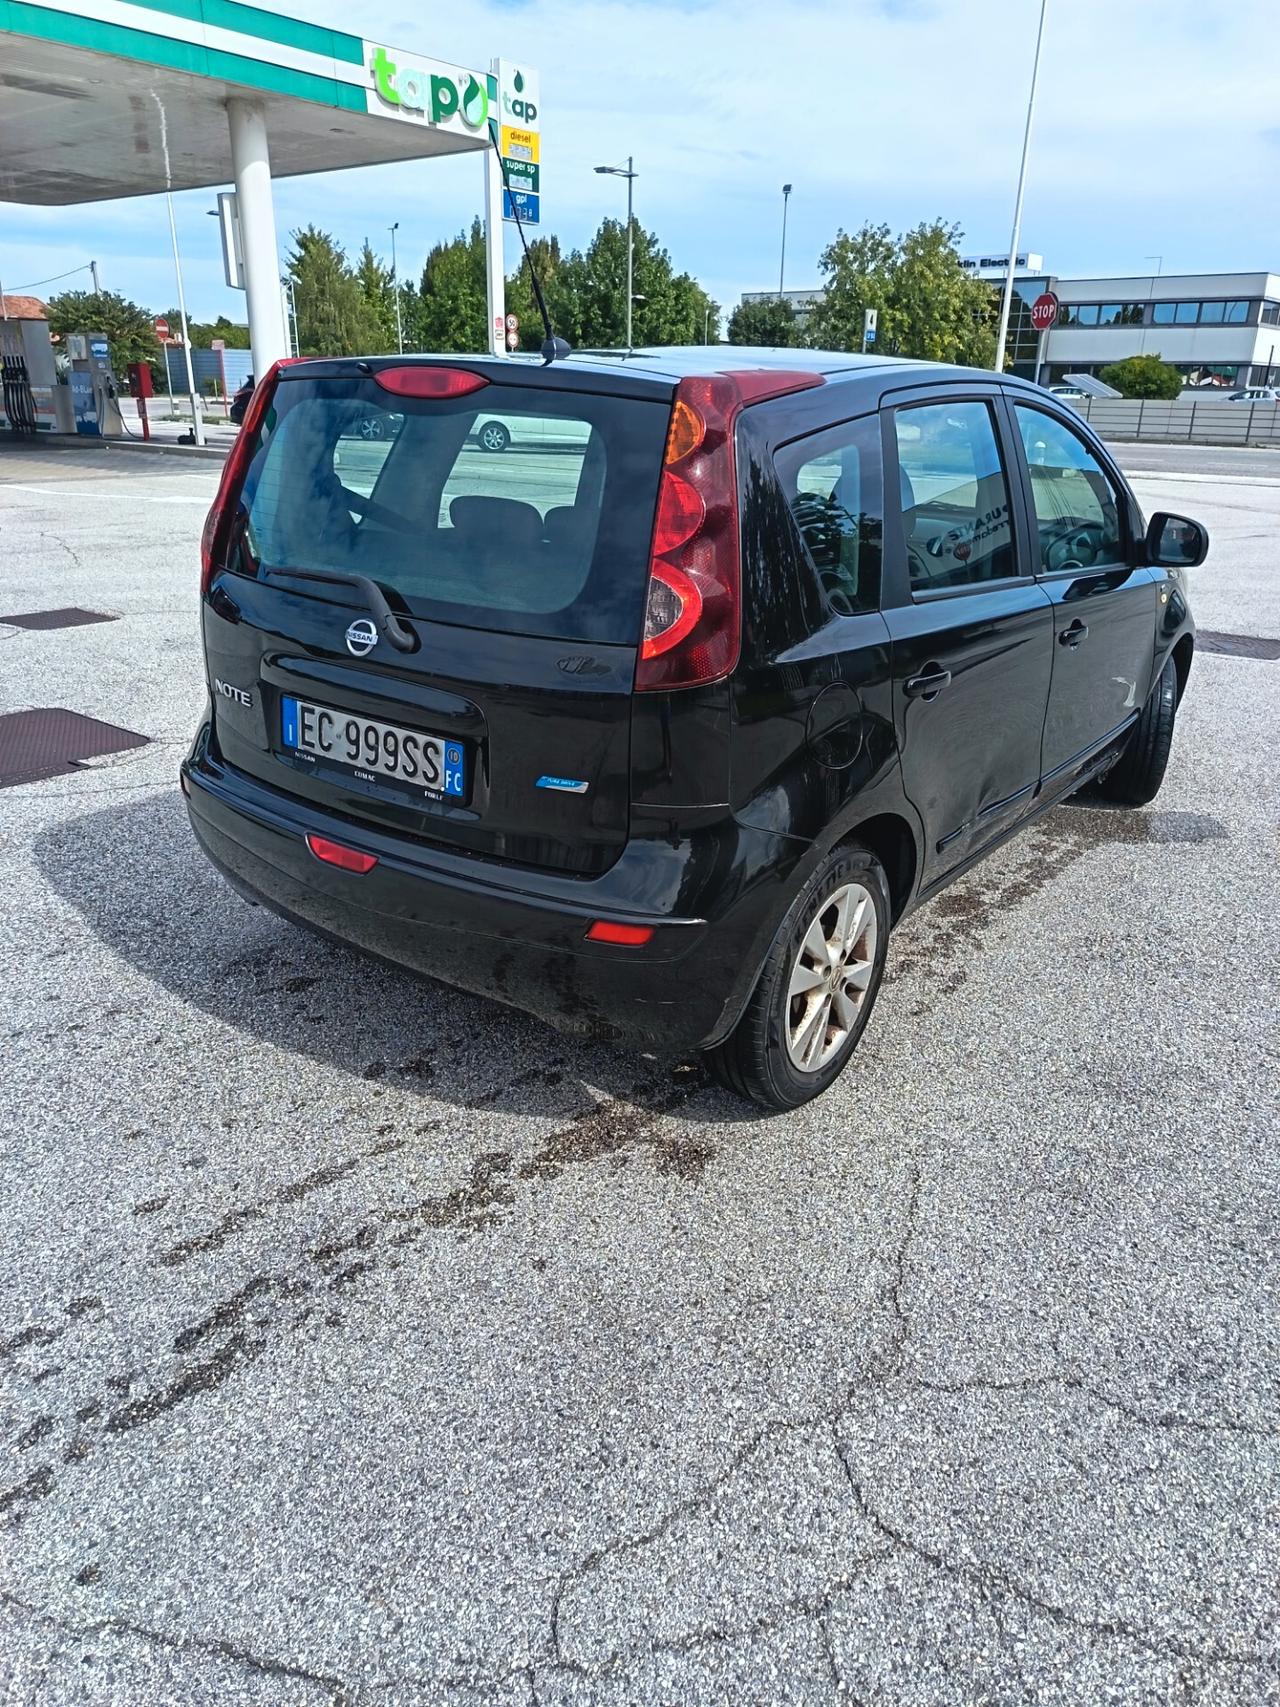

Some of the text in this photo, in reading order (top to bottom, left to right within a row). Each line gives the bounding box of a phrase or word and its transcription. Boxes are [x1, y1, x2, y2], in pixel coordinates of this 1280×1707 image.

[371, 47, 459, 124] tap
[503, 91, 538, 124] tap
[510, 131, 531, 144] diesel
[506, 160, 536, 174] super sp
[516, 194, 527, 204] gpl
[980, 258, 1025, 267] Electic
[1033, 305, 1055, 319] STOP
[346, 630, 374, 643] NISSAN
[215, 679, 252, 708] NOTE
[300, 705, 439, 783] EC 999SS
[445, 770, 461, 791] FC
